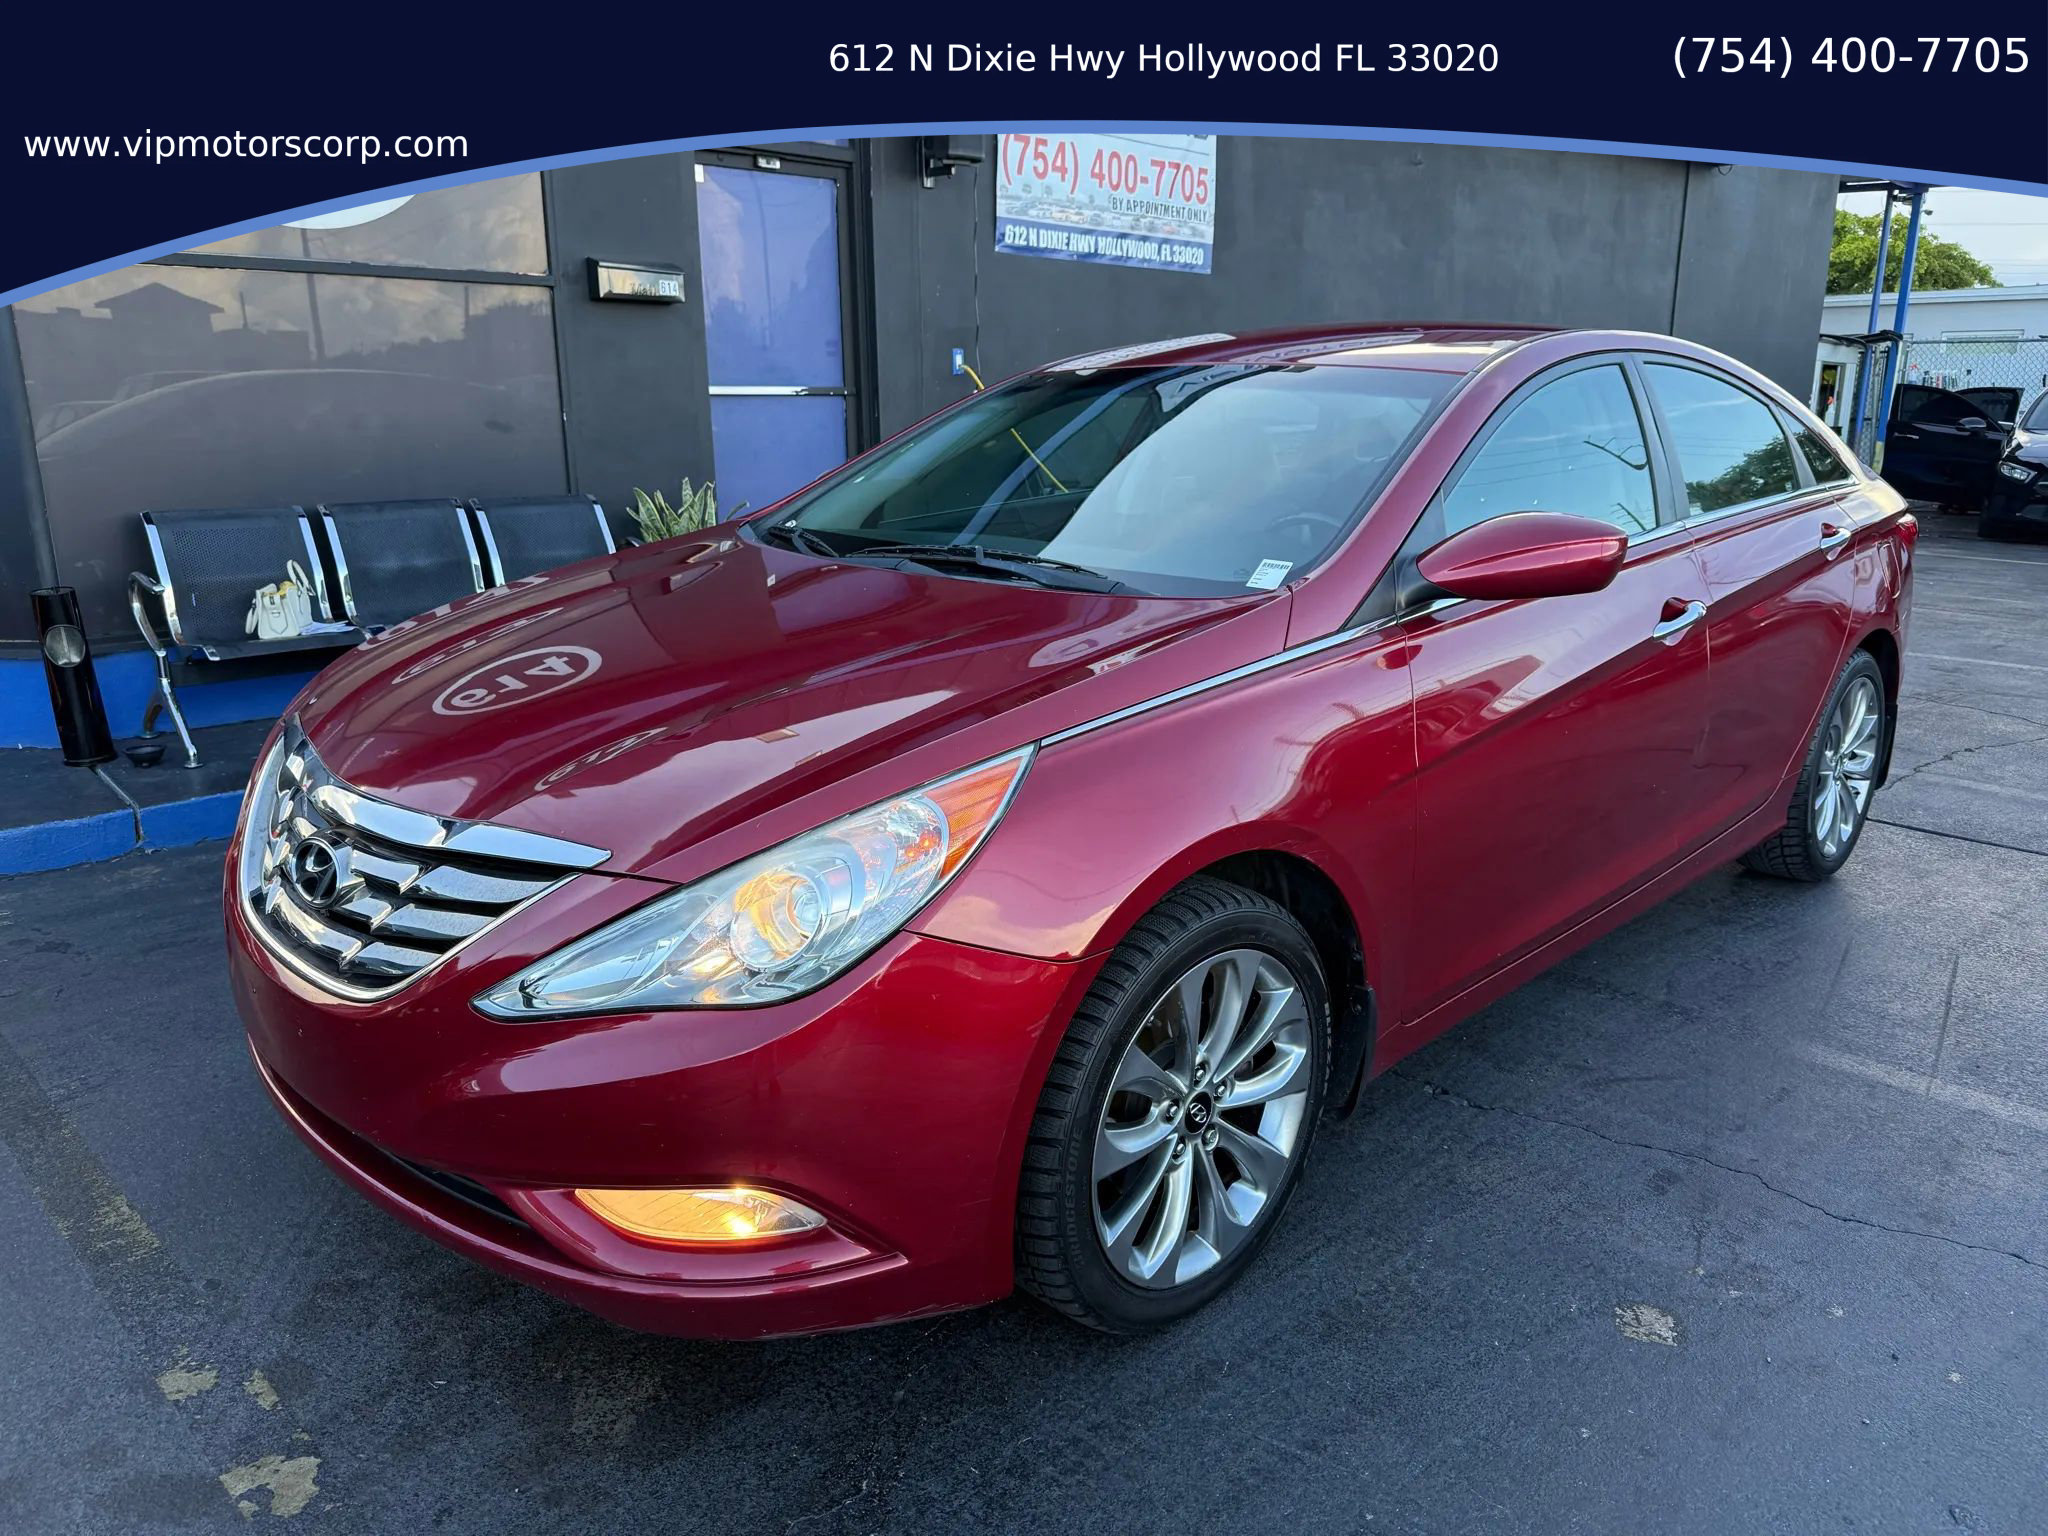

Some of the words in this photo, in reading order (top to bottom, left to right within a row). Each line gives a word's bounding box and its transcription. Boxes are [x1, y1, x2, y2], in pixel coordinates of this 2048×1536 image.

[1002, 134, 1078, 194] (754)
[1090, 149, 1209, 205] 400-7705
[1112, 197, 1124, 211] BY
[1126, 199, 1185, 219] APPOINTMENT
[1187, 207, 1208, 222] ONLY
[1004, 224, 1028, 246] 612
[1028, 227, 1038, 247] N
[1039, 229, 1069, 251] DIXIE
[1069, 232, 1096, 254] HWY
[1096, 236, 1160, 262] HOLLYWOOD,
[1161, 244, 1172, 262] FL
[1172, 245, 1204, 266] 33020
[660, 281, 679, 295] 614
